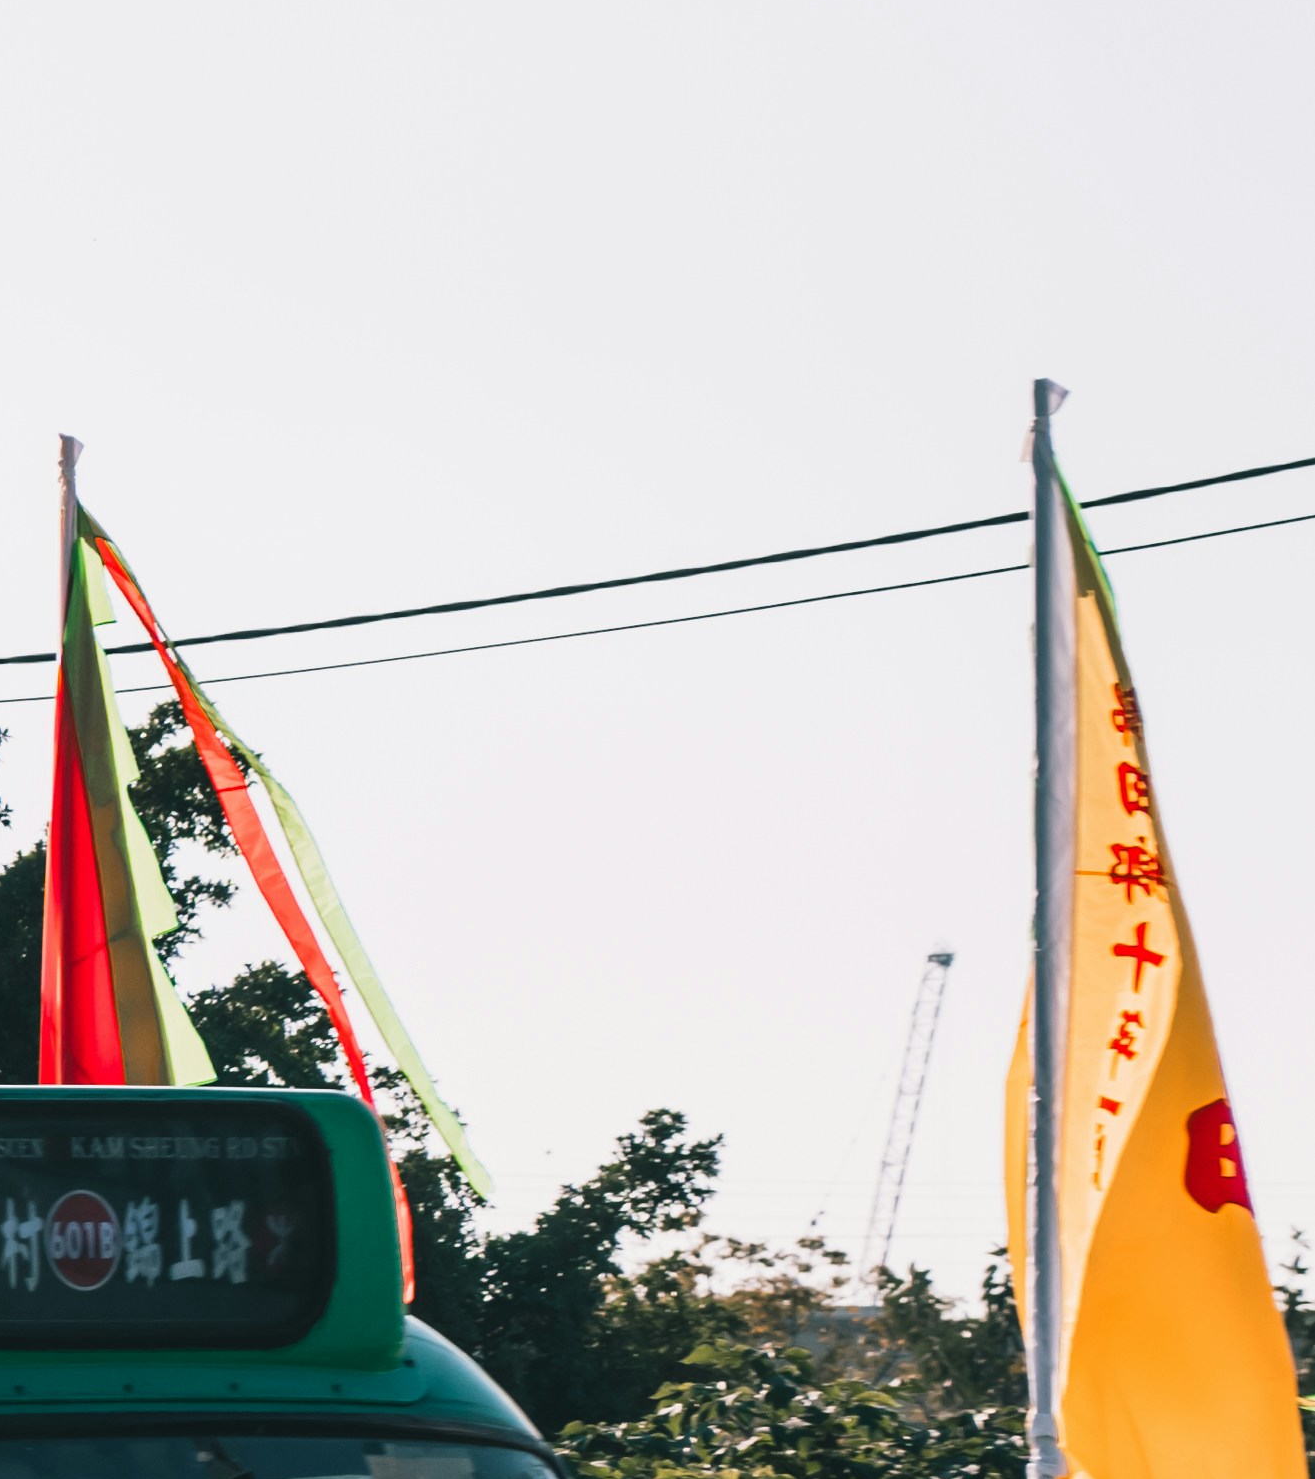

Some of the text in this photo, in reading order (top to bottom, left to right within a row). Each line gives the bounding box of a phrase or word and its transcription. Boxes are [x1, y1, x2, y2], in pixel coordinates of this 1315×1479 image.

[71, 1136, 124, 1158] KAM
[50, 1222, 115, 1259] 601B
[124, 1197, 250, 1287] 錦上路
